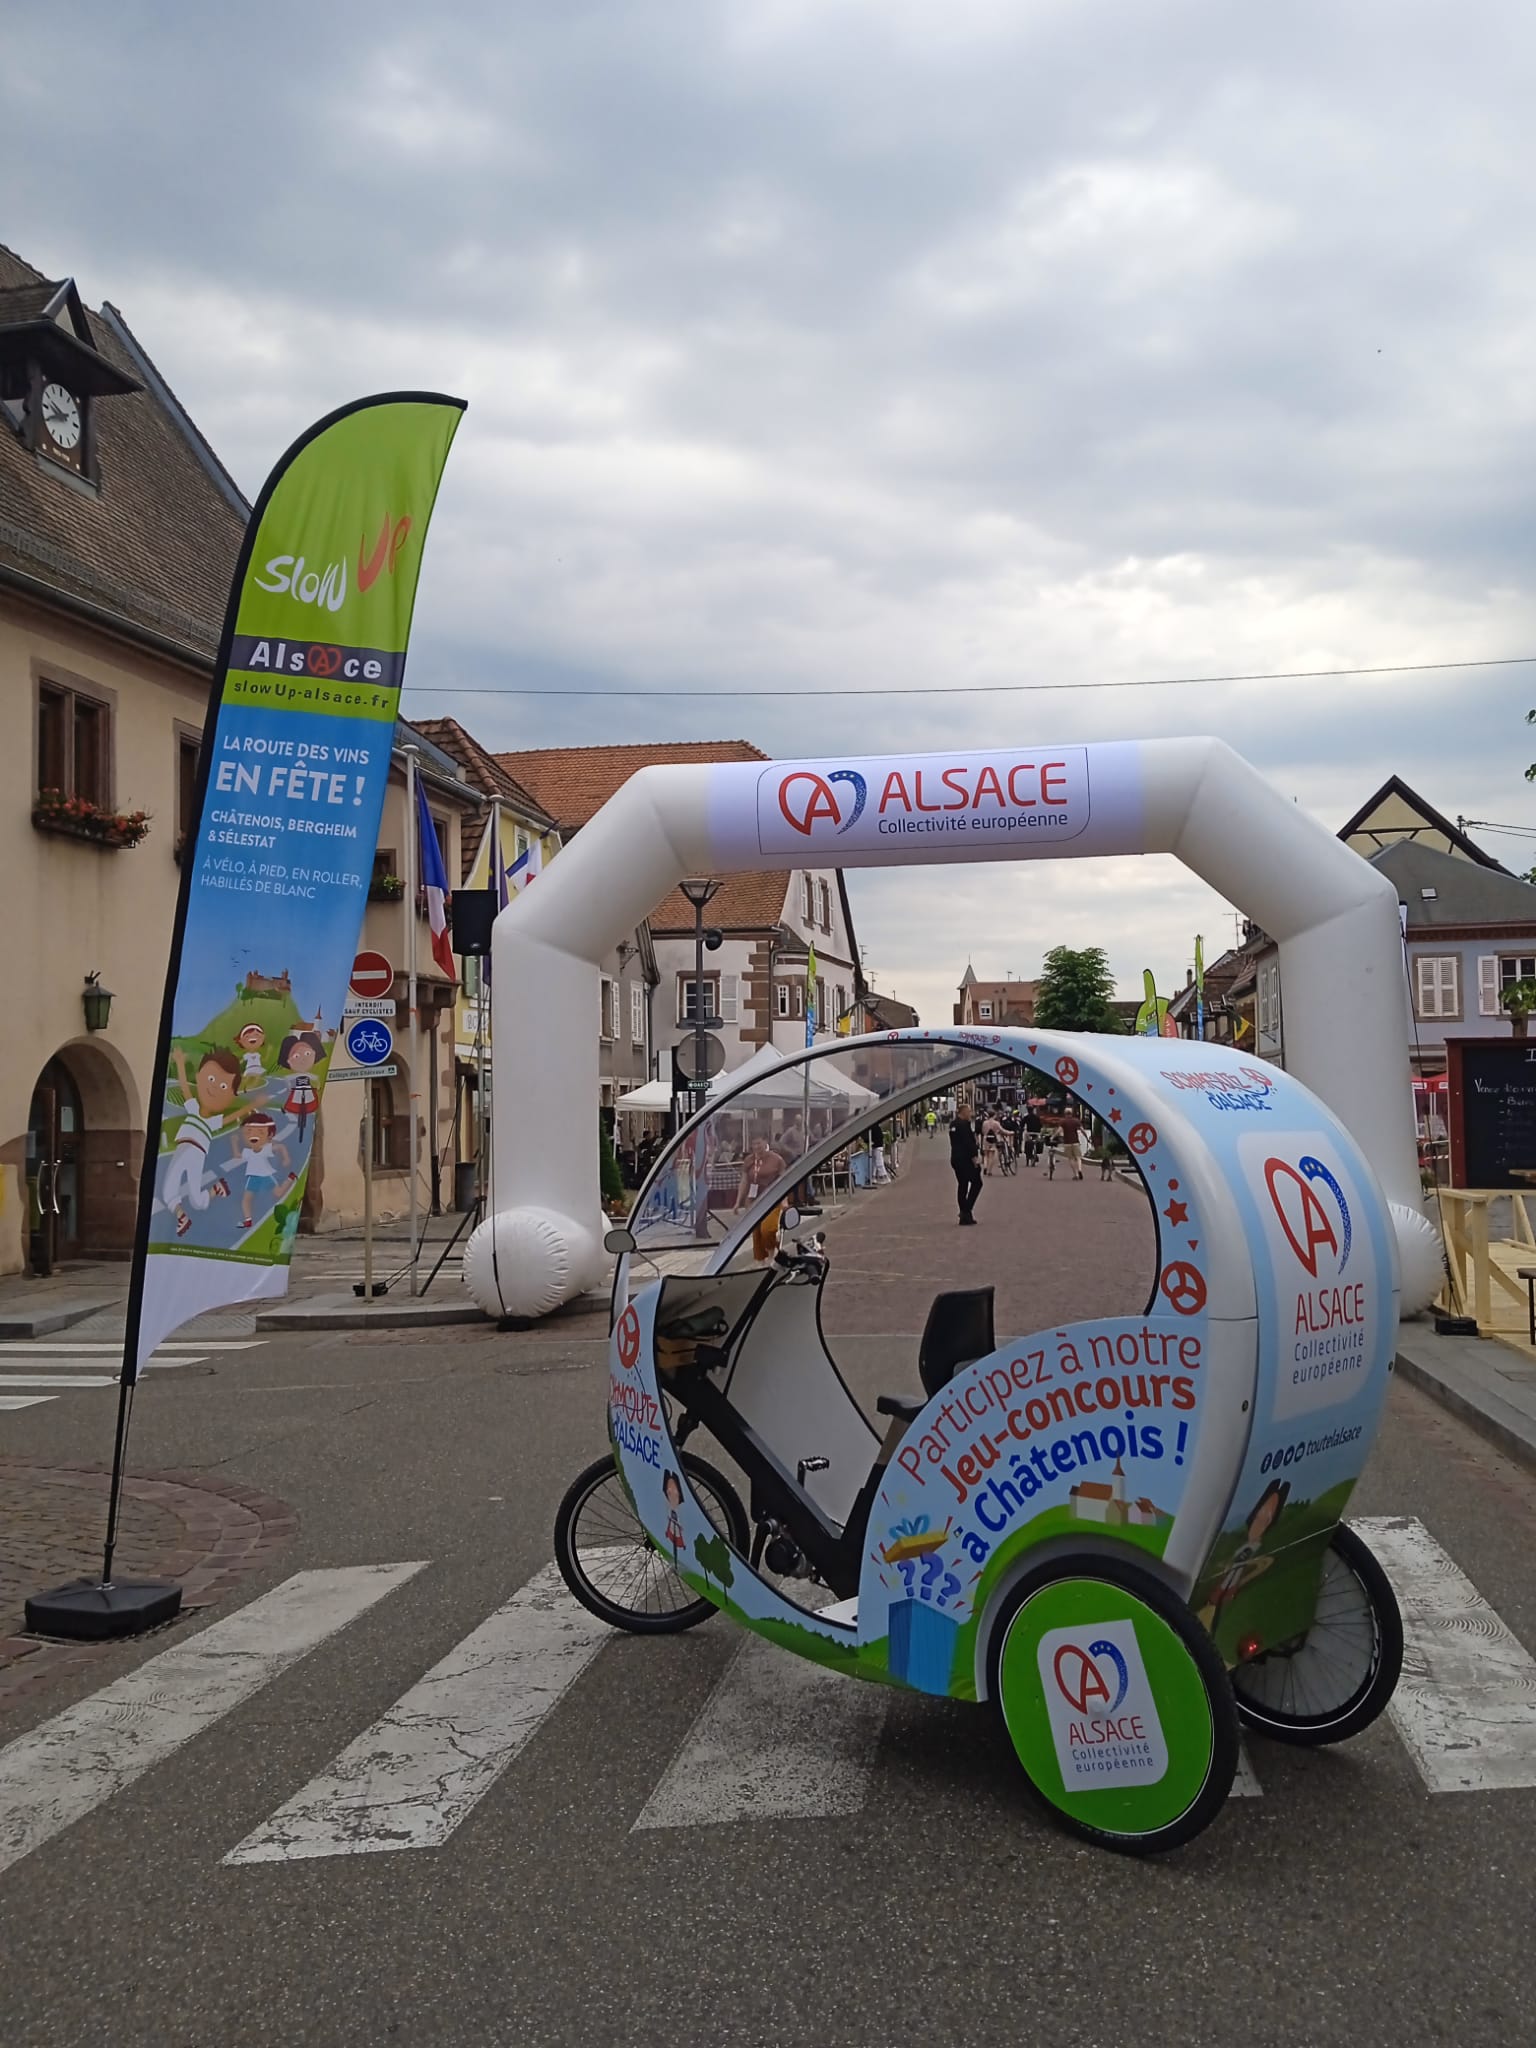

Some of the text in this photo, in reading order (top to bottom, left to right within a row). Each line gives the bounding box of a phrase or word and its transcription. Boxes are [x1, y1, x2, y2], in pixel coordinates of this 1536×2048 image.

[223, 735, 370, 765] LA ROUTE DES VINS
[215, 760, 261, 795] EN
[268, 760, 347, 804] FÊTE
[878, 761, 1068, 814] ALSACE
[207, 829, 277, 848] & SÉLESTAT
[211, 809, 357, 839] CHÂTENOIS, BERGHEIM
[878, 812, 1068, 835] Collectivité européenne
[201, 874, 316, 899] HABILLÉS DE BLANC
[292, 868, 310, 883] EN
[312, 871, 363, 889] ROLLER,
[1295, 1283, 1365, 1335] ALSACE
[1294, 1328, 1365, 1362] Collectivité
[1292, 1352, 1363, 1384] européenne
[897, 1326, 1201, 1486] Participez à notre
[953, 1526, 991, 1563] à
[974, 1410, 1164, 1532] Châtenois
[1069, 1715, 1146, 1746] ALSACE
[1072, 1743, 1151, 1761] Collectivité
[1076, 1756, 1153, 1773] européenne
